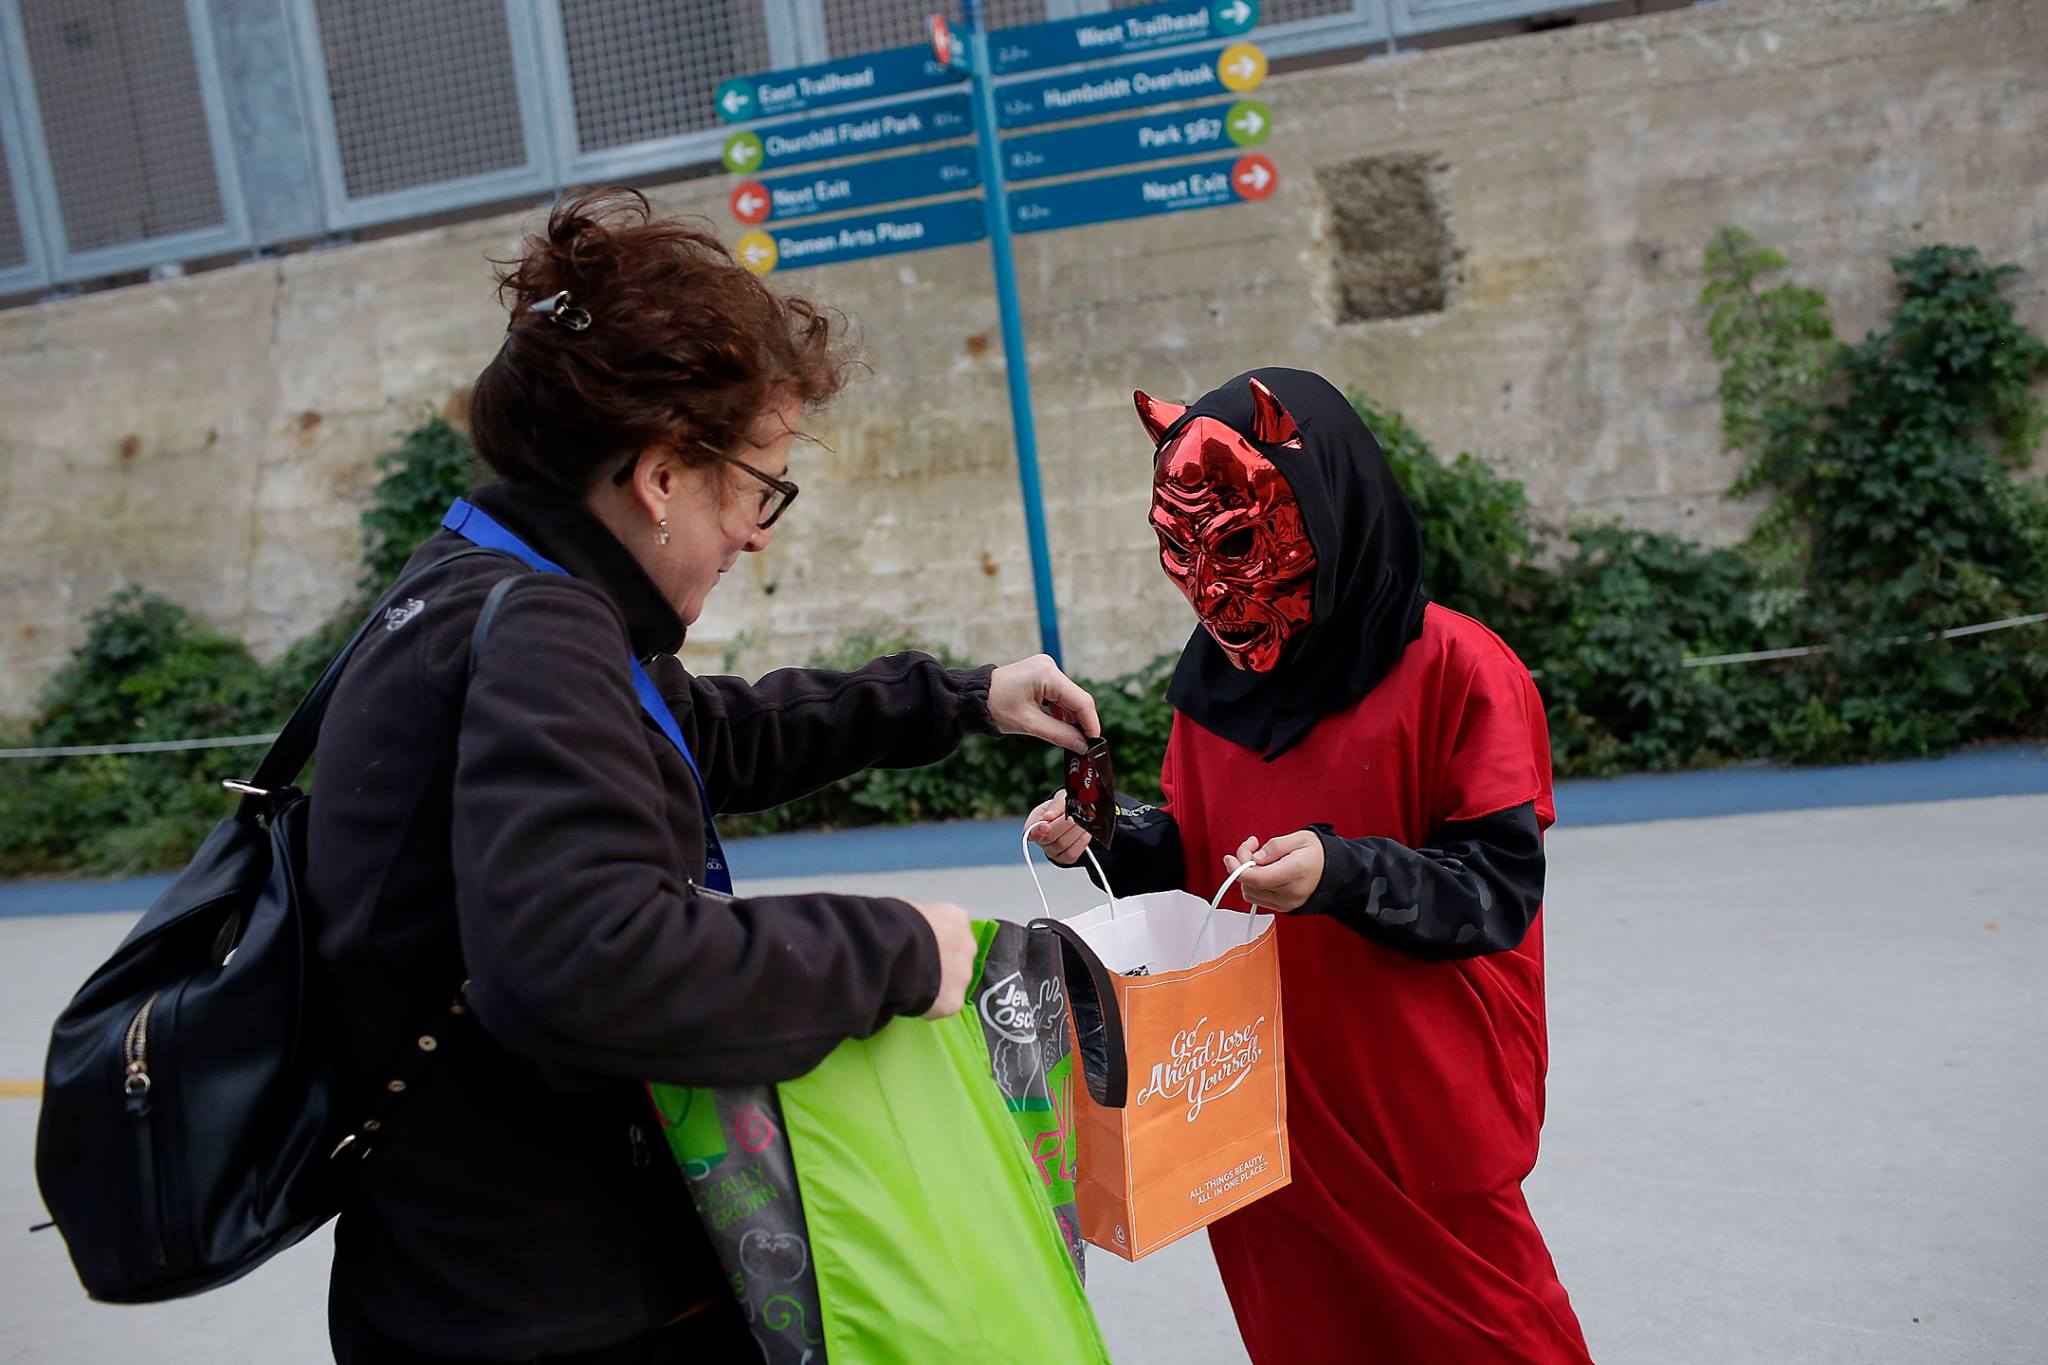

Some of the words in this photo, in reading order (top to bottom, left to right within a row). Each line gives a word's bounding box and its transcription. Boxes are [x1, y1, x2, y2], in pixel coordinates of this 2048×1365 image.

[1076, 25, 1123, 48] West
[1126, 7, 1210, 39] Trailhead
[758, 83, 797, 105] East
[798, 66, 875, 97] Trailhead
[1043, 78, 1131, 109] Humboldt
[1132, 63, 1216, 94] Overlook
[766, 129, 837, 158] Churchill
[838, 119, 881, 145] Field
[882, 112, 922, 136] Park
[1139, 124, 1182, 149] Park
[1183, 118, 1223, 144] 567
[772, 183, 813, 206] Next
[815, 178, 851, 200] Exit
[1142, 180, 1188, 202] Next
[1189, 172, 1229, 196] Exit
[780, 234, 836, 258] Damen
[838, 227, 877, 248] Arts
[877, 221, 925, 243] Plaza
[1171, 1016, 1208, 1068] Go
[1210, 1016, 1265, 1067] Lose
[1186, 1034, 1263, 1123] Yourself.
[1189, 1186, 1204, 1200] ALL
[1204, 1170, 1233, 1190] THINGS
[1197, 1192, 1212, 1206] ALL
[1213, 1186, 1223, 1198] IN
[1223, 1177, 1240, 1192] ONE
[712, 1183, 779, 1230] GROWN
